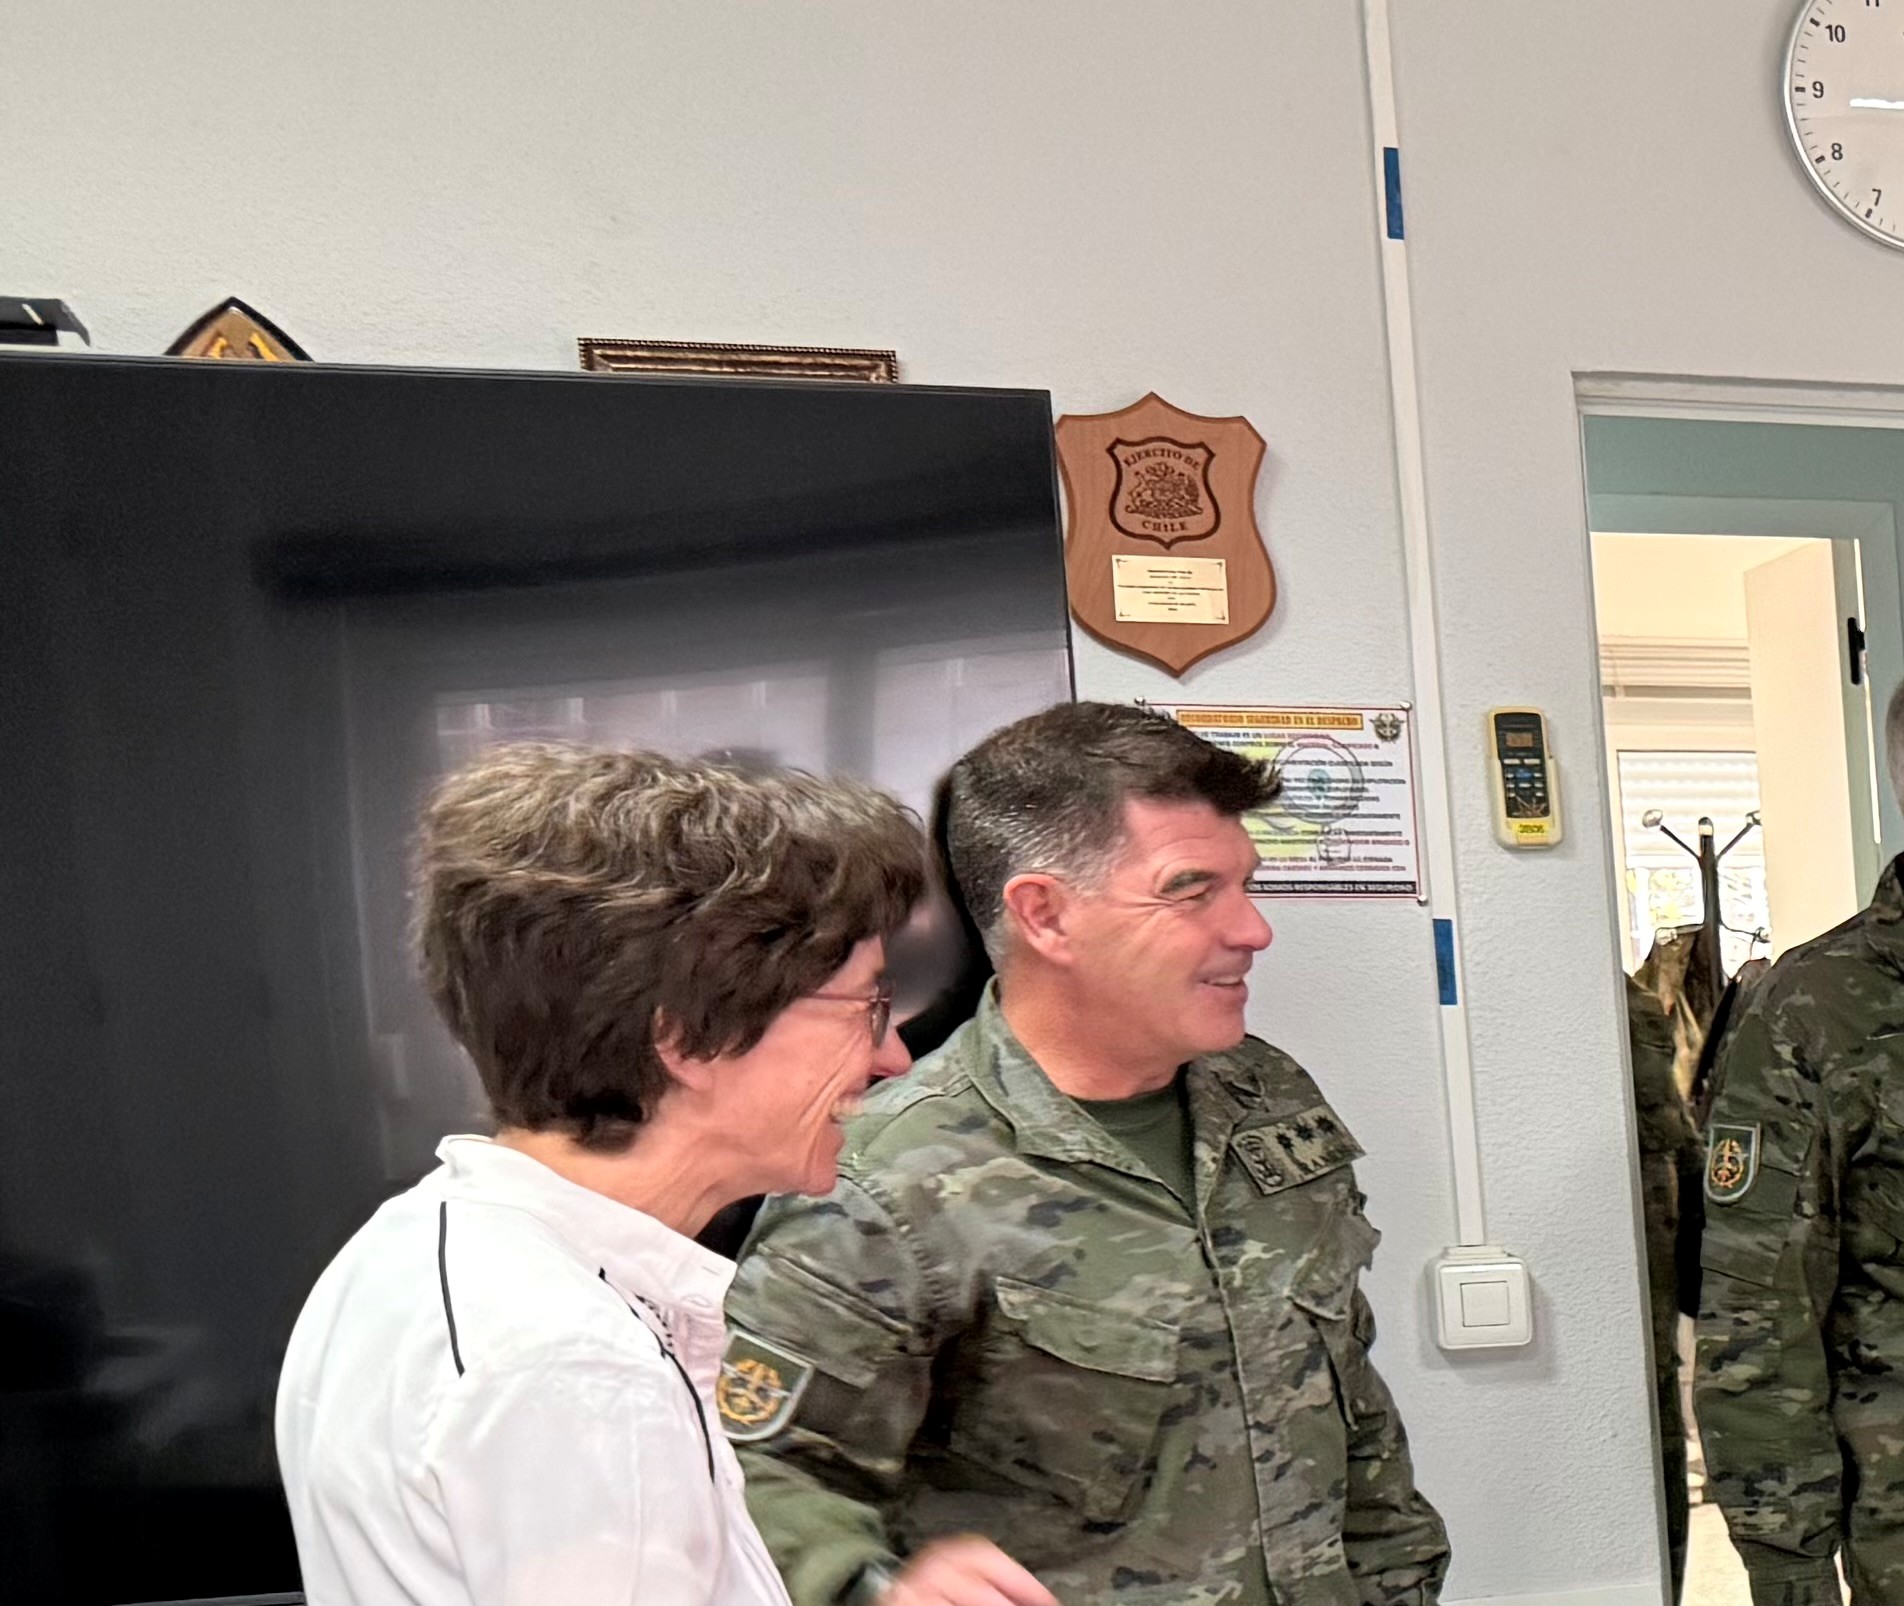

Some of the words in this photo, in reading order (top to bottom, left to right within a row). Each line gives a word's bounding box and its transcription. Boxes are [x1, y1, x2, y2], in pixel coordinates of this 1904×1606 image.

[1826, 25, 1846, 43] 10
[1812, 81, 1824, 99] 9
[1831, 143, 1843, 161] 8
[1872, 189, 1883, 207] 7
[1141, 520, 1187, 533] CHILE
